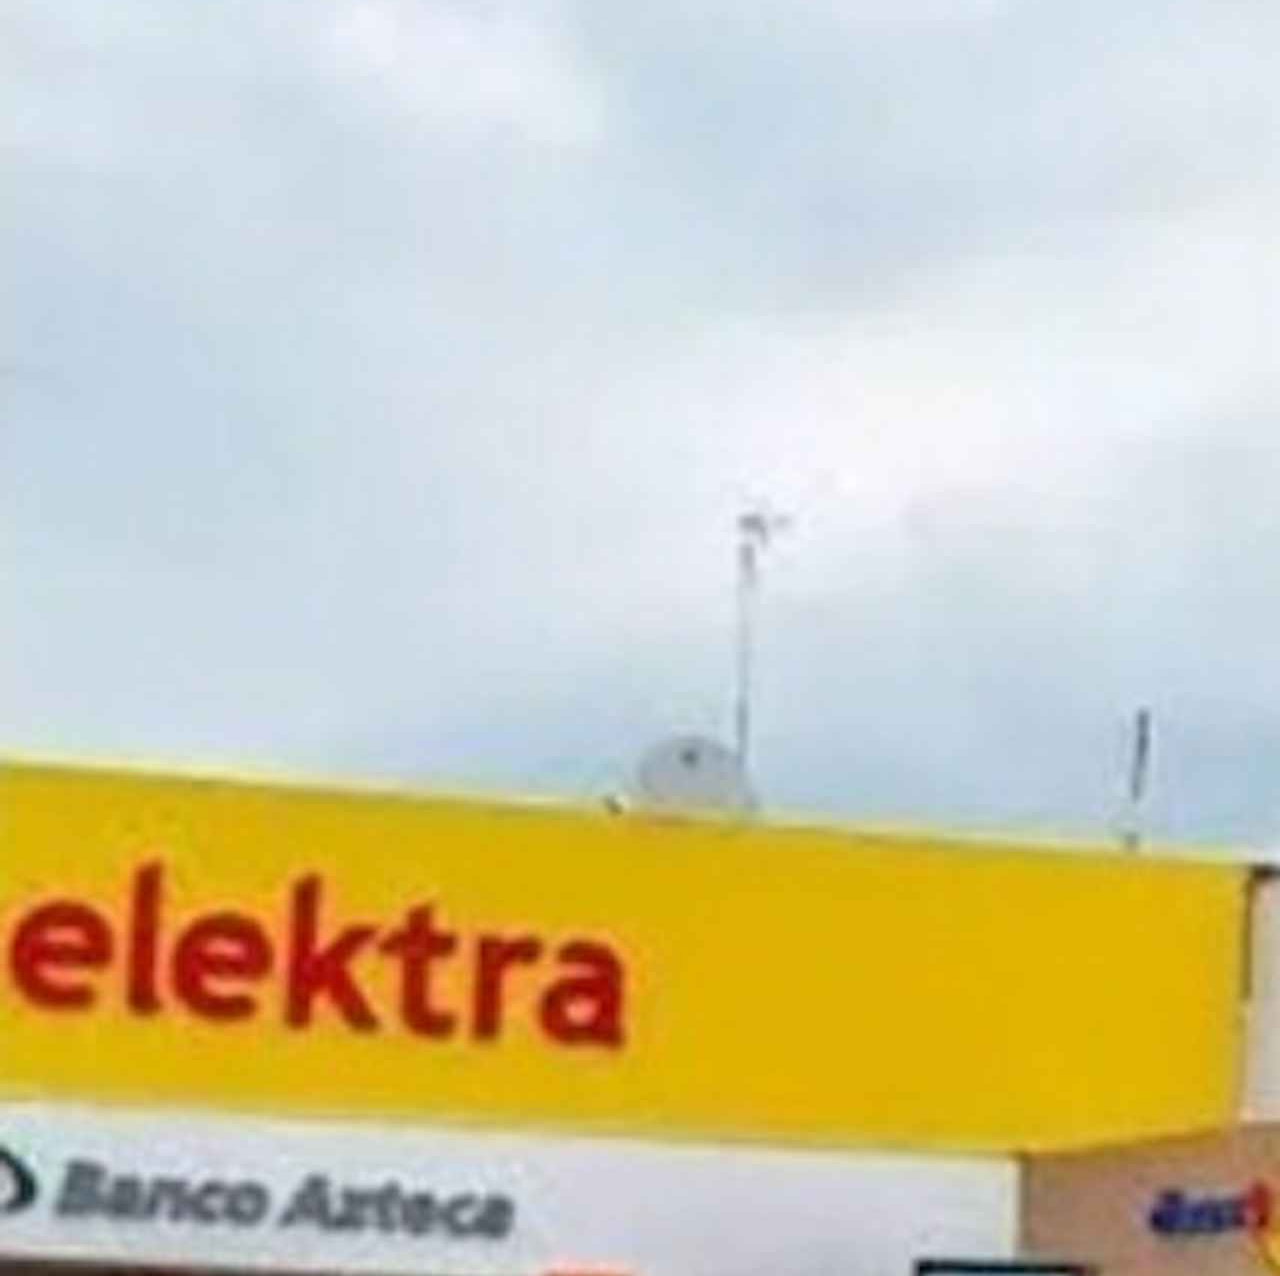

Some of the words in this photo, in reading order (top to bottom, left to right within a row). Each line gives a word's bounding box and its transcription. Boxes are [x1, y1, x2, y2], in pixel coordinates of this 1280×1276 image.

[9, 860, 626, 1052] elektra
[55, 1160, 268, 1226] Banco
[280, 1174, 517, 1240] Azteca
